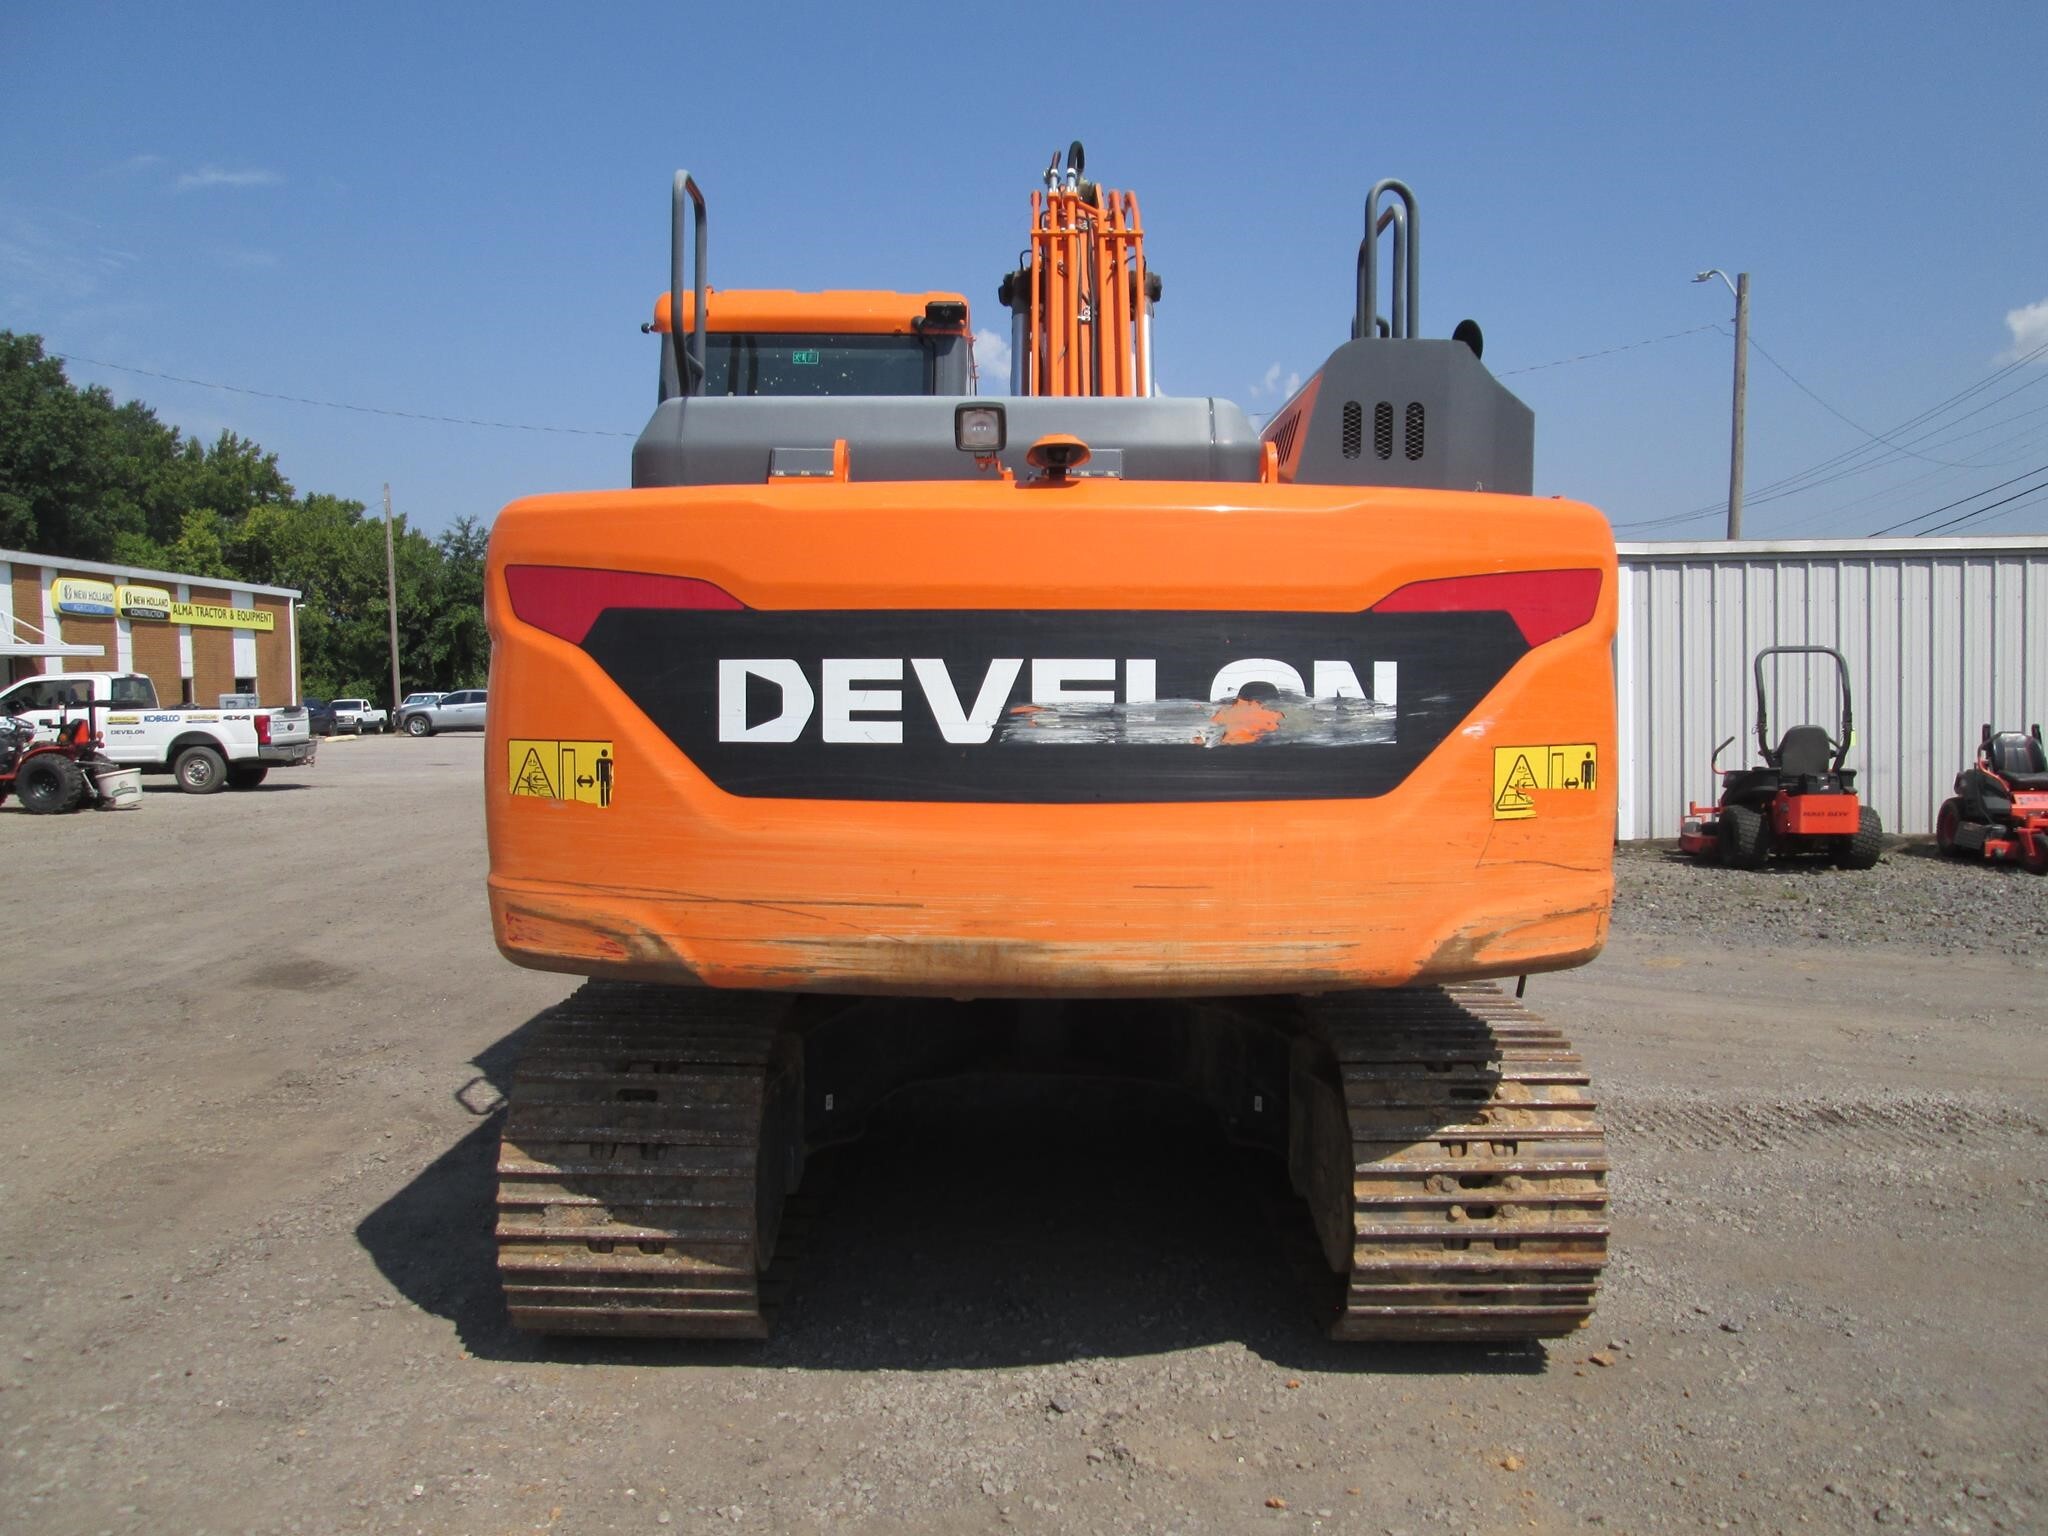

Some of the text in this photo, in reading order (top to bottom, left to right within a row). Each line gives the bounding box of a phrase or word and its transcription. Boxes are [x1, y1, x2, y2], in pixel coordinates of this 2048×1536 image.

[73, 590, 112, 602] NEW HOLLAND
[133, 595, 169, 607] NEW HOLLAND
[173, 604, 272, 623] ALMA TRACTOR & EQUIPMENT
[144, 714, 180, 723] KOBELCO
